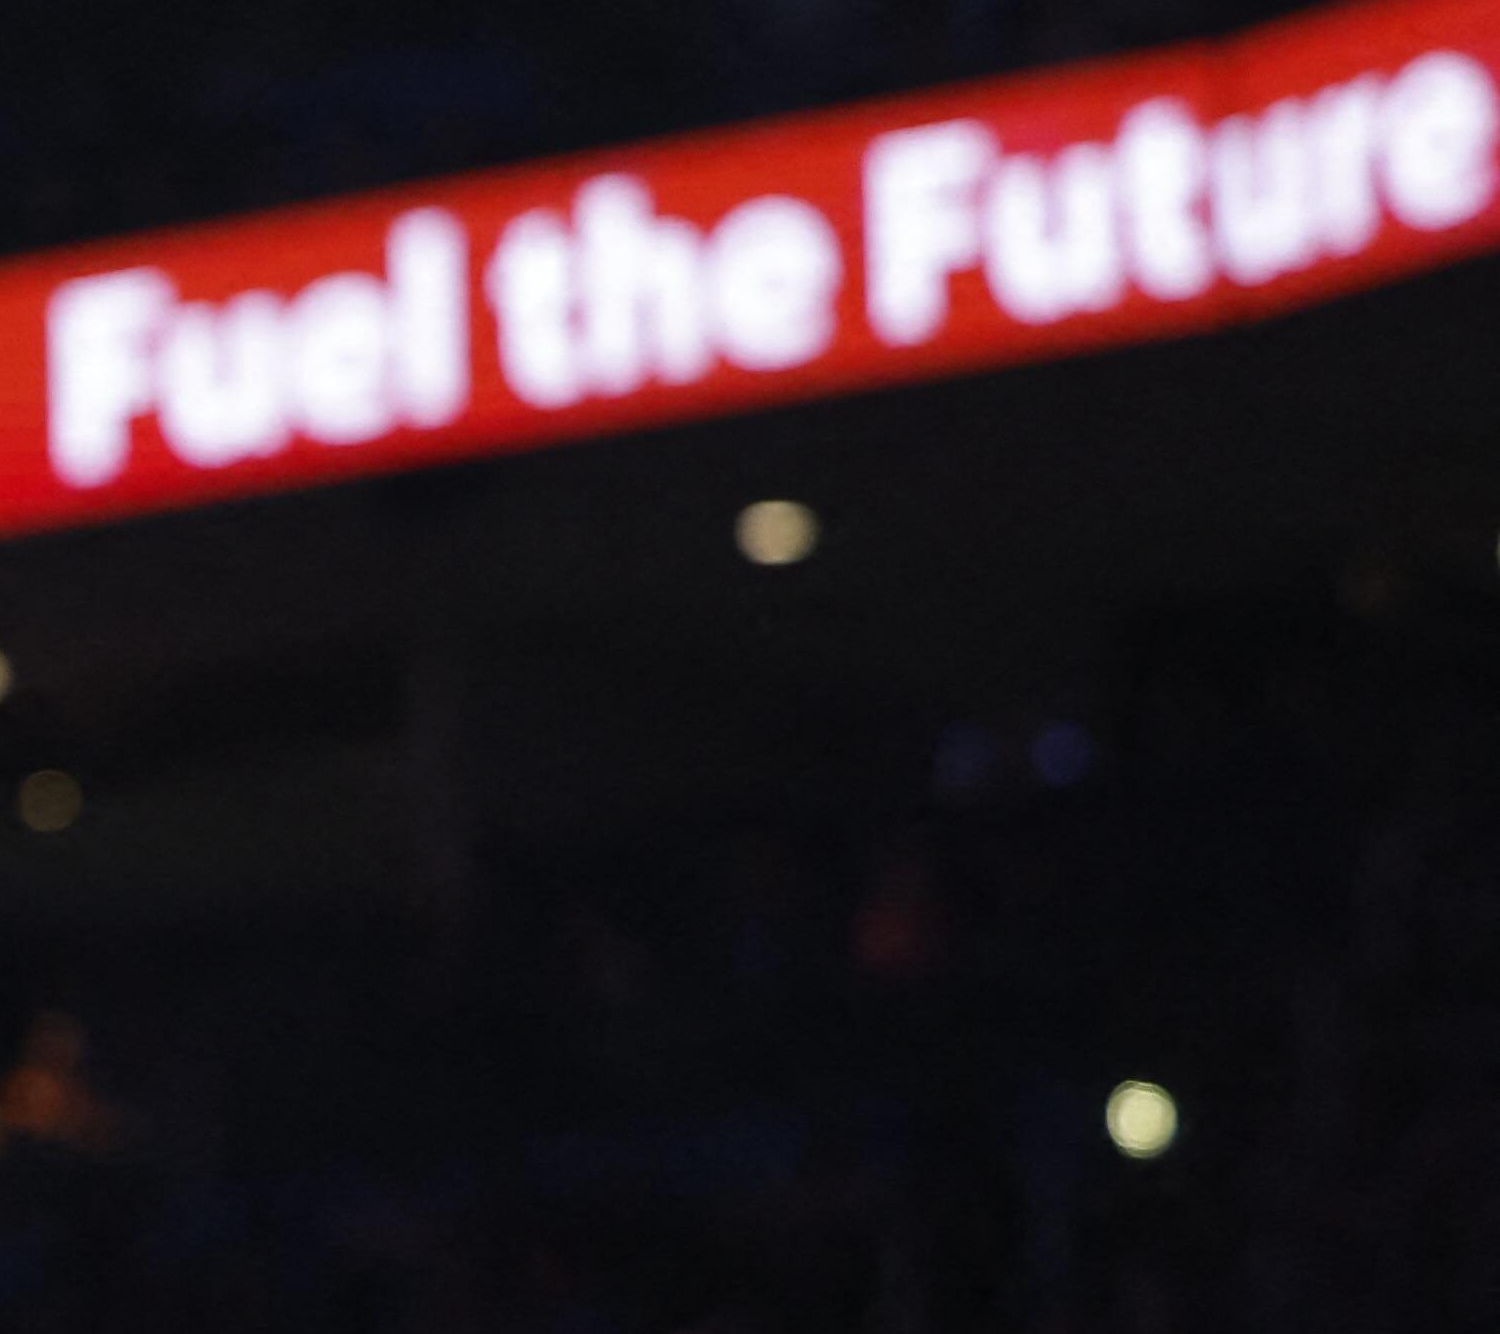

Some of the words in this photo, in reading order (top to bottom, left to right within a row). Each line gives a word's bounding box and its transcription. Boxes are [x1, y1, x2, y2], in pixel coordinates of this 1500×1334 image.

[47, 207, 471, 488] Fuel
[485, 173, 843, 407] the
[862, 50, 1500, 347] Future
